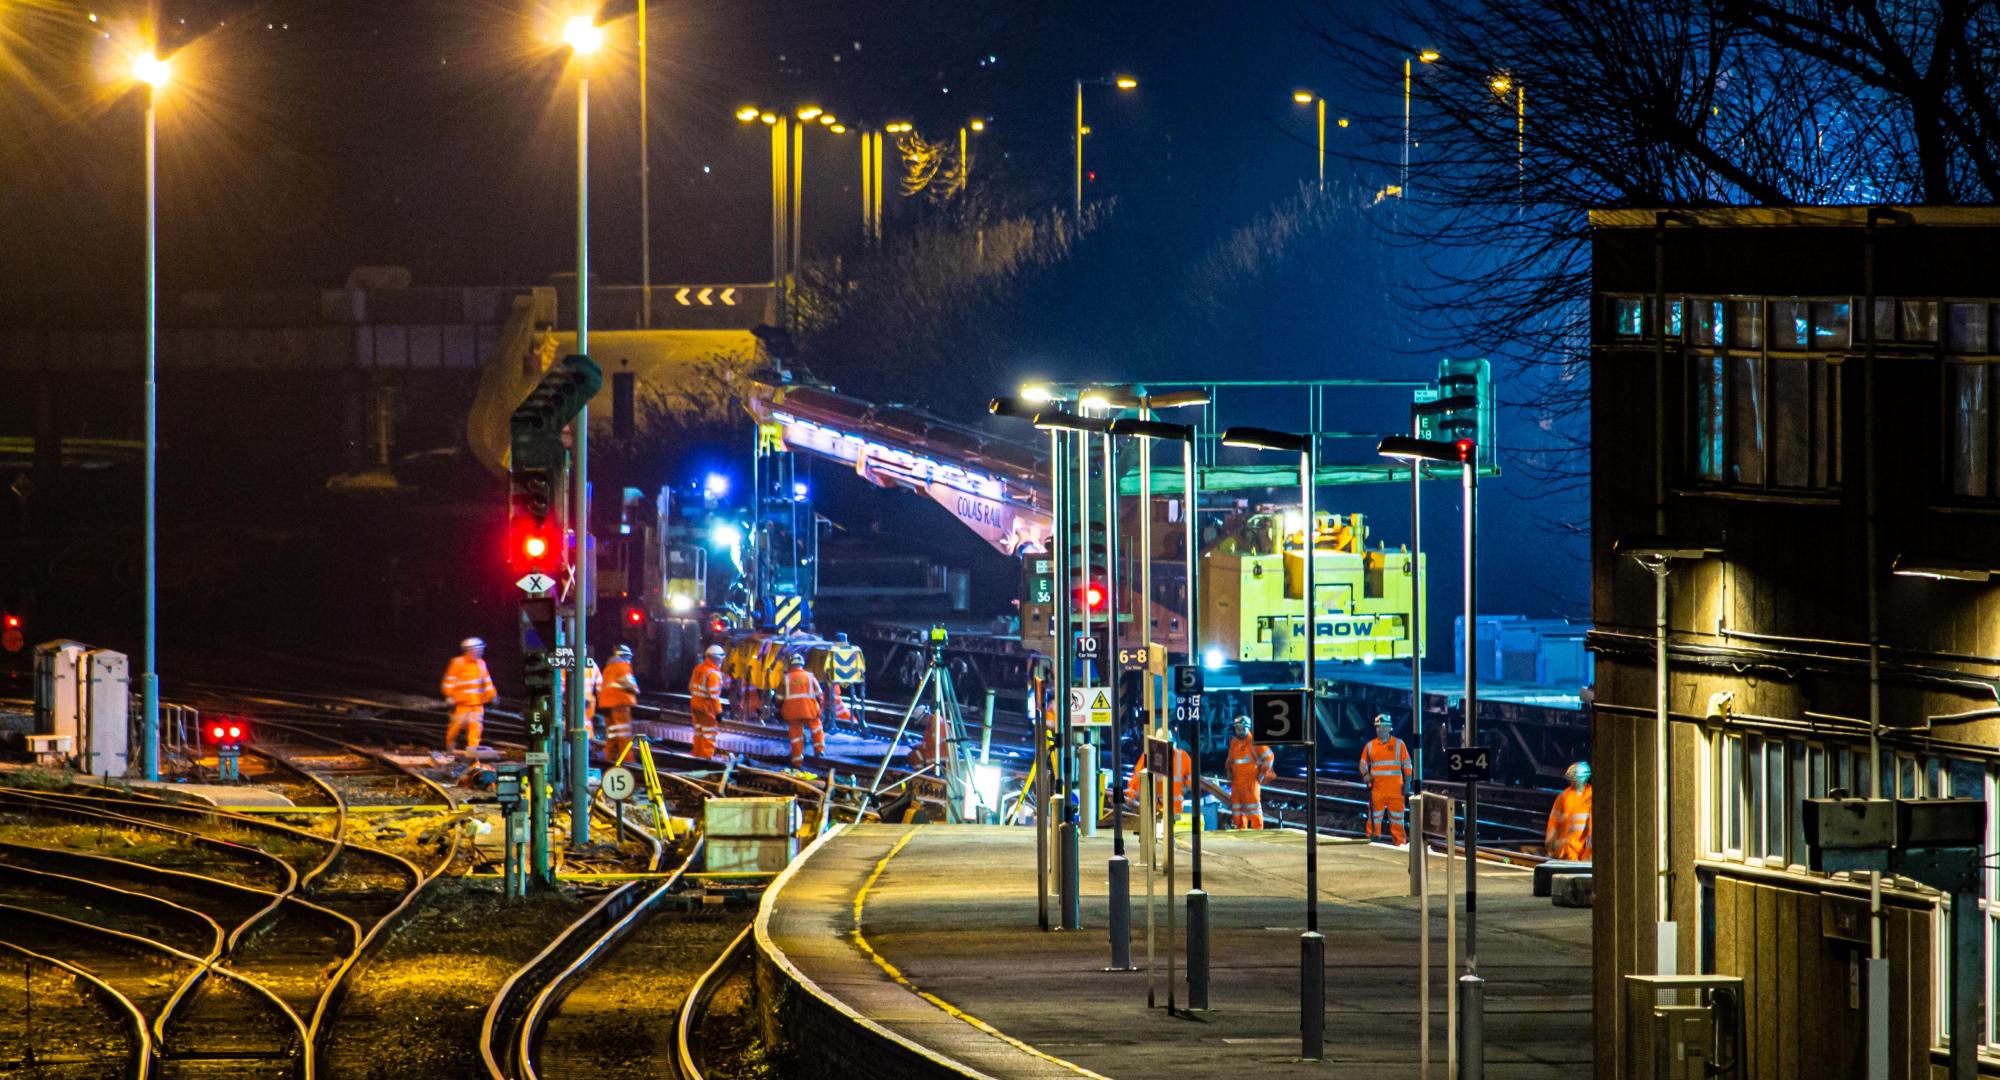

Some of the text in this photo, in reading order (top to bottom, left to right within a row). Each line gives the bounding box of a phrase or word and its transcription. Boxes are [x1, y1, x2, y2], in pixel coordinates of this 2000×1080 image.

[1422, 418, 1428, 428] E
[957, 496, 1001, 529] COLAS RAIL
[530, 576, 542, 591] X
[1040, 580, 1047, 590] E
[1038, 592, 1051, 603] 36
[1293, 622, 1373, 637] KROW
[1079, 637, 1097, 652] 10
[1182, 667, 1196, 688] 5
[534, 712, 541, 722] E
[1266, 699, 1291, 737] 3
[530, 724, 544, 735] 34
[610, 775, 626, 792] 15
